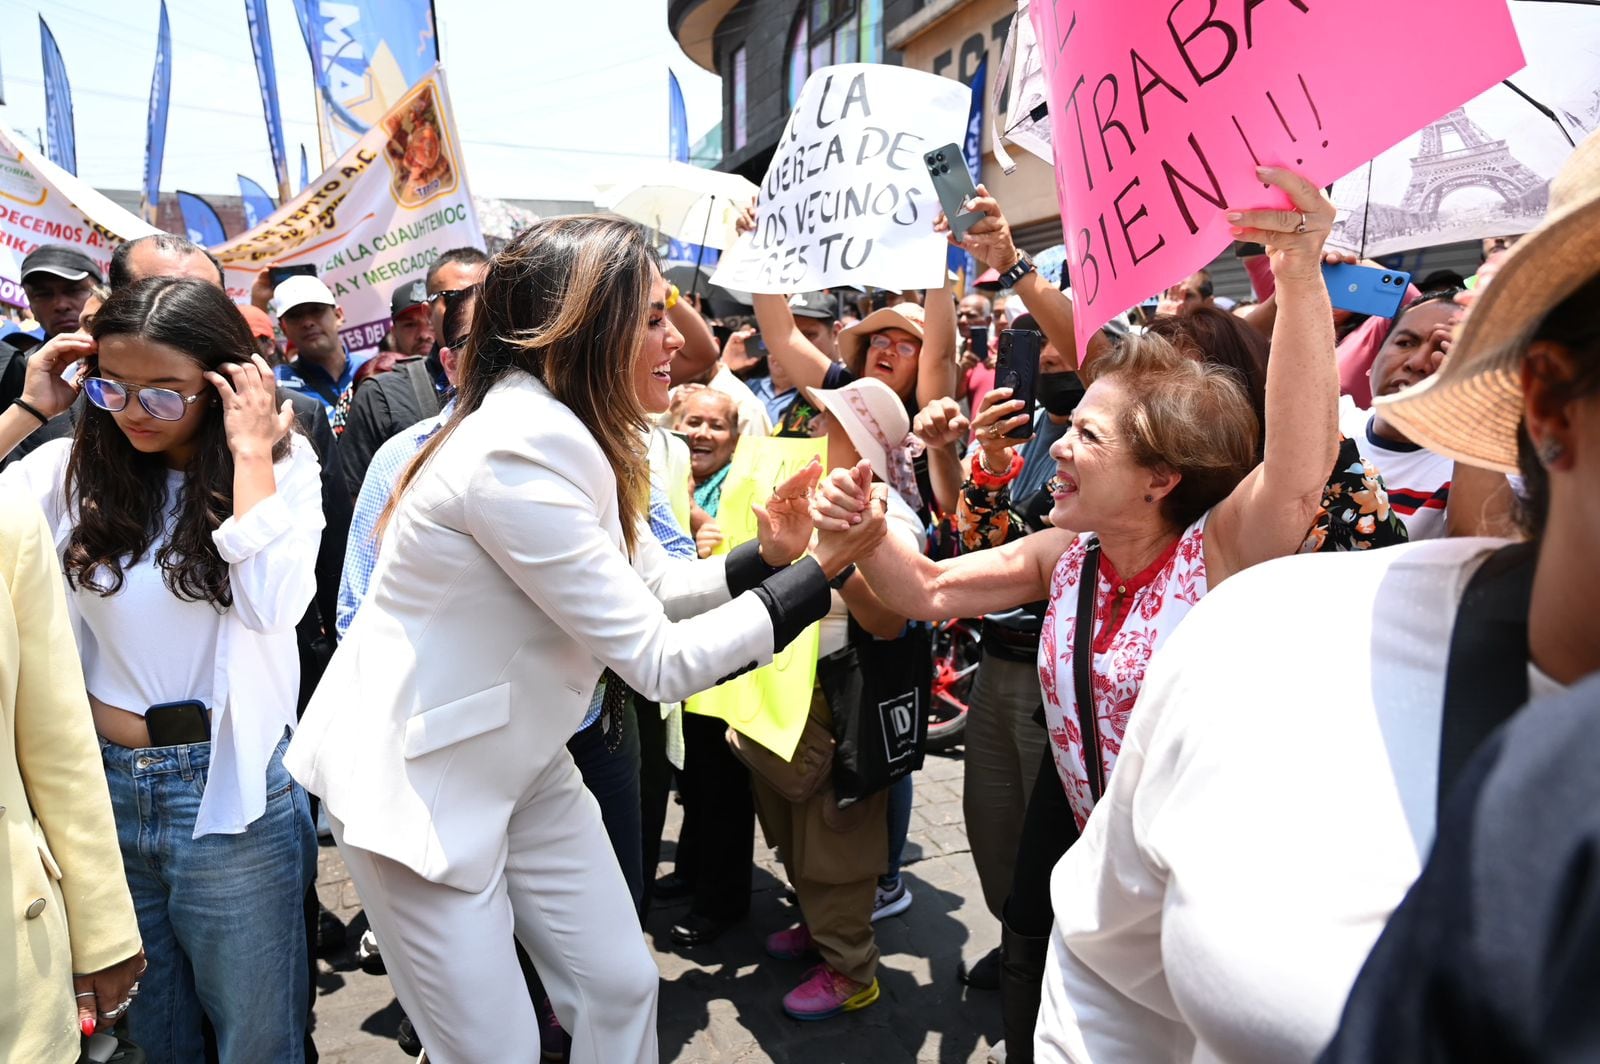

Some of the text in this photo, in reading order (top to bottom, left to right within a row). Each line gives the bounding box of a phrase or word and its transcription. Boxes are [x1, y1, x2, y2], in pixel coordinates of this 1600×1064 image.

[816, 72, 871, 128] LA
[767, 126, 925, 201] UERZA DE
[346, 243, 373, 262] LA
[372, 203, 467, 252] CUAUHTEMOC
[751, 205, 787, 249] LOS
[795, 182, 922, 226] VECINOS
[346, 275, 362, 291] Y
[362, 246, 439, 286] MERCADOS
[819, 232, 874, 273] TU
